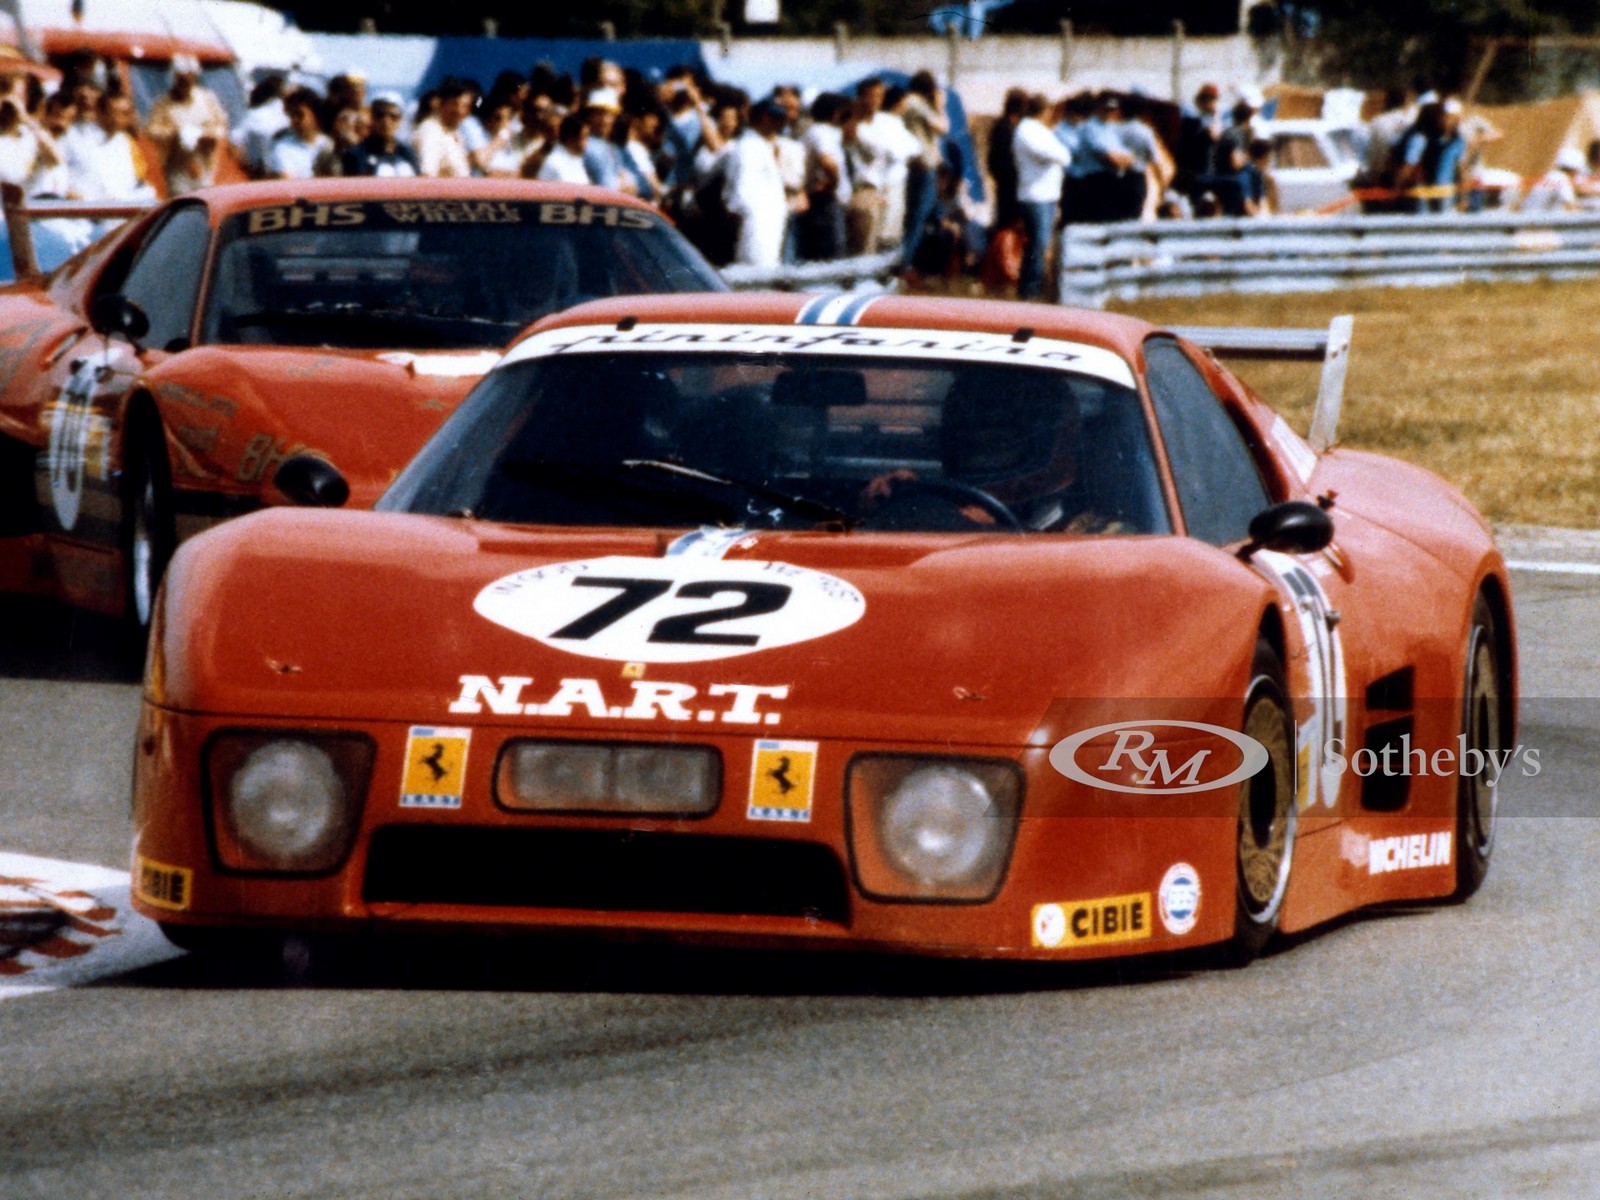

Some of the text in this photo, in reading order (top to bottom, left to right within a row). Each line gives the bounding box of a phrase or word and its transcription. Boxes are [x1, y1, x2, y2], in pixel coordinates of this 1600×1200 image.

[248, 203, 367, 234] BHS
[538, 202, 656, 231] BHS
[550, 330, 1081, 362] pininfarina
[548, 576, 793, 647] 72
[448, 674, 790, 725] N.A.R.T.
[1070, 901, 1144, 938] CIBIE
